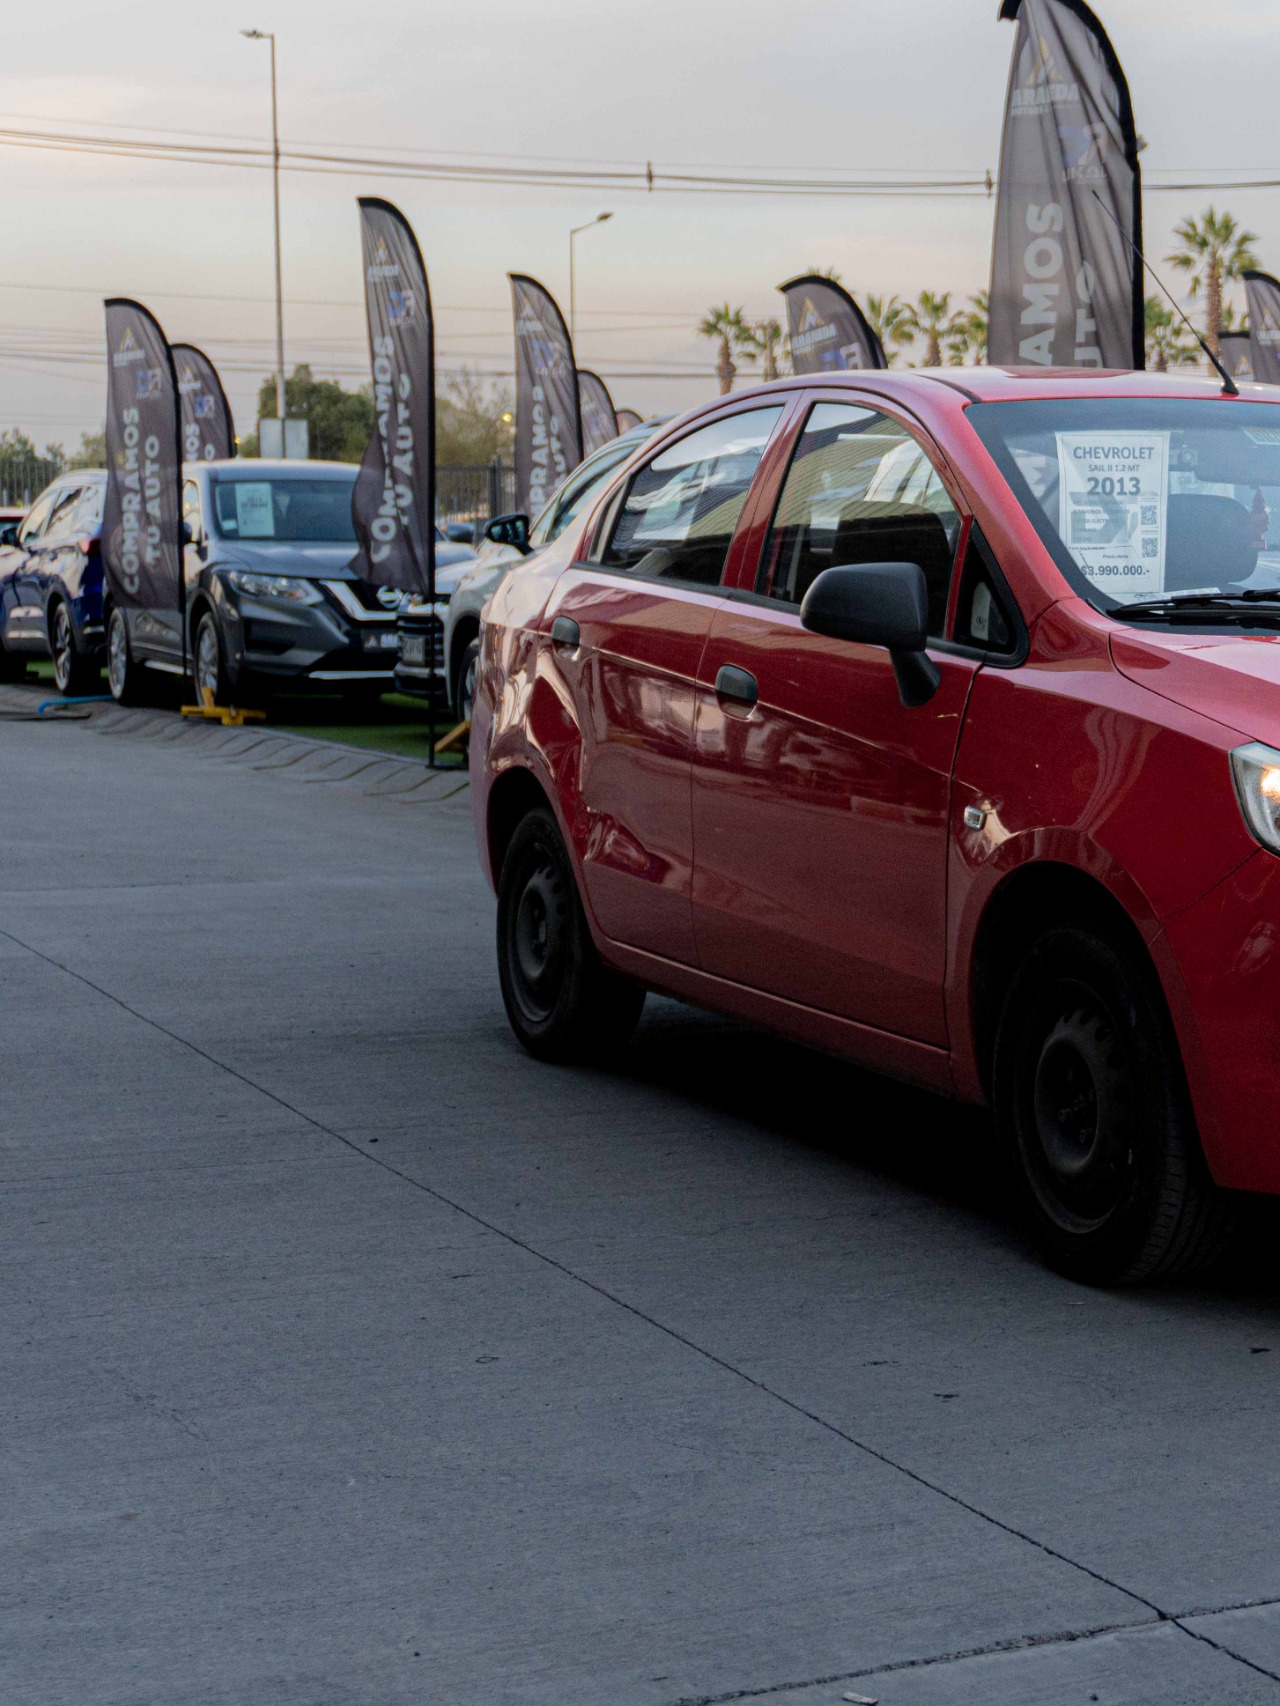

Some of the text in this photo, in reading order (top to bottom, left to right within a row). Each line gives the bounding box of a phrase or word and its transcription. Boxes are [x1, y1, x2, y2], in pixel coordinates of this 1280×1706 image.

[1073, 446, 1154, 460] CHEVROLET
[145, 434, 162, 521] AUTO
[1088, 464, 1106, 473] SAIL
[1115, 464, 1126, 473] 1.2
[1127, 464, 1141, 473] MT
[1086, 476, 1141, 497] 2013
[122, 407, 142, 595] COMPRAMOS
